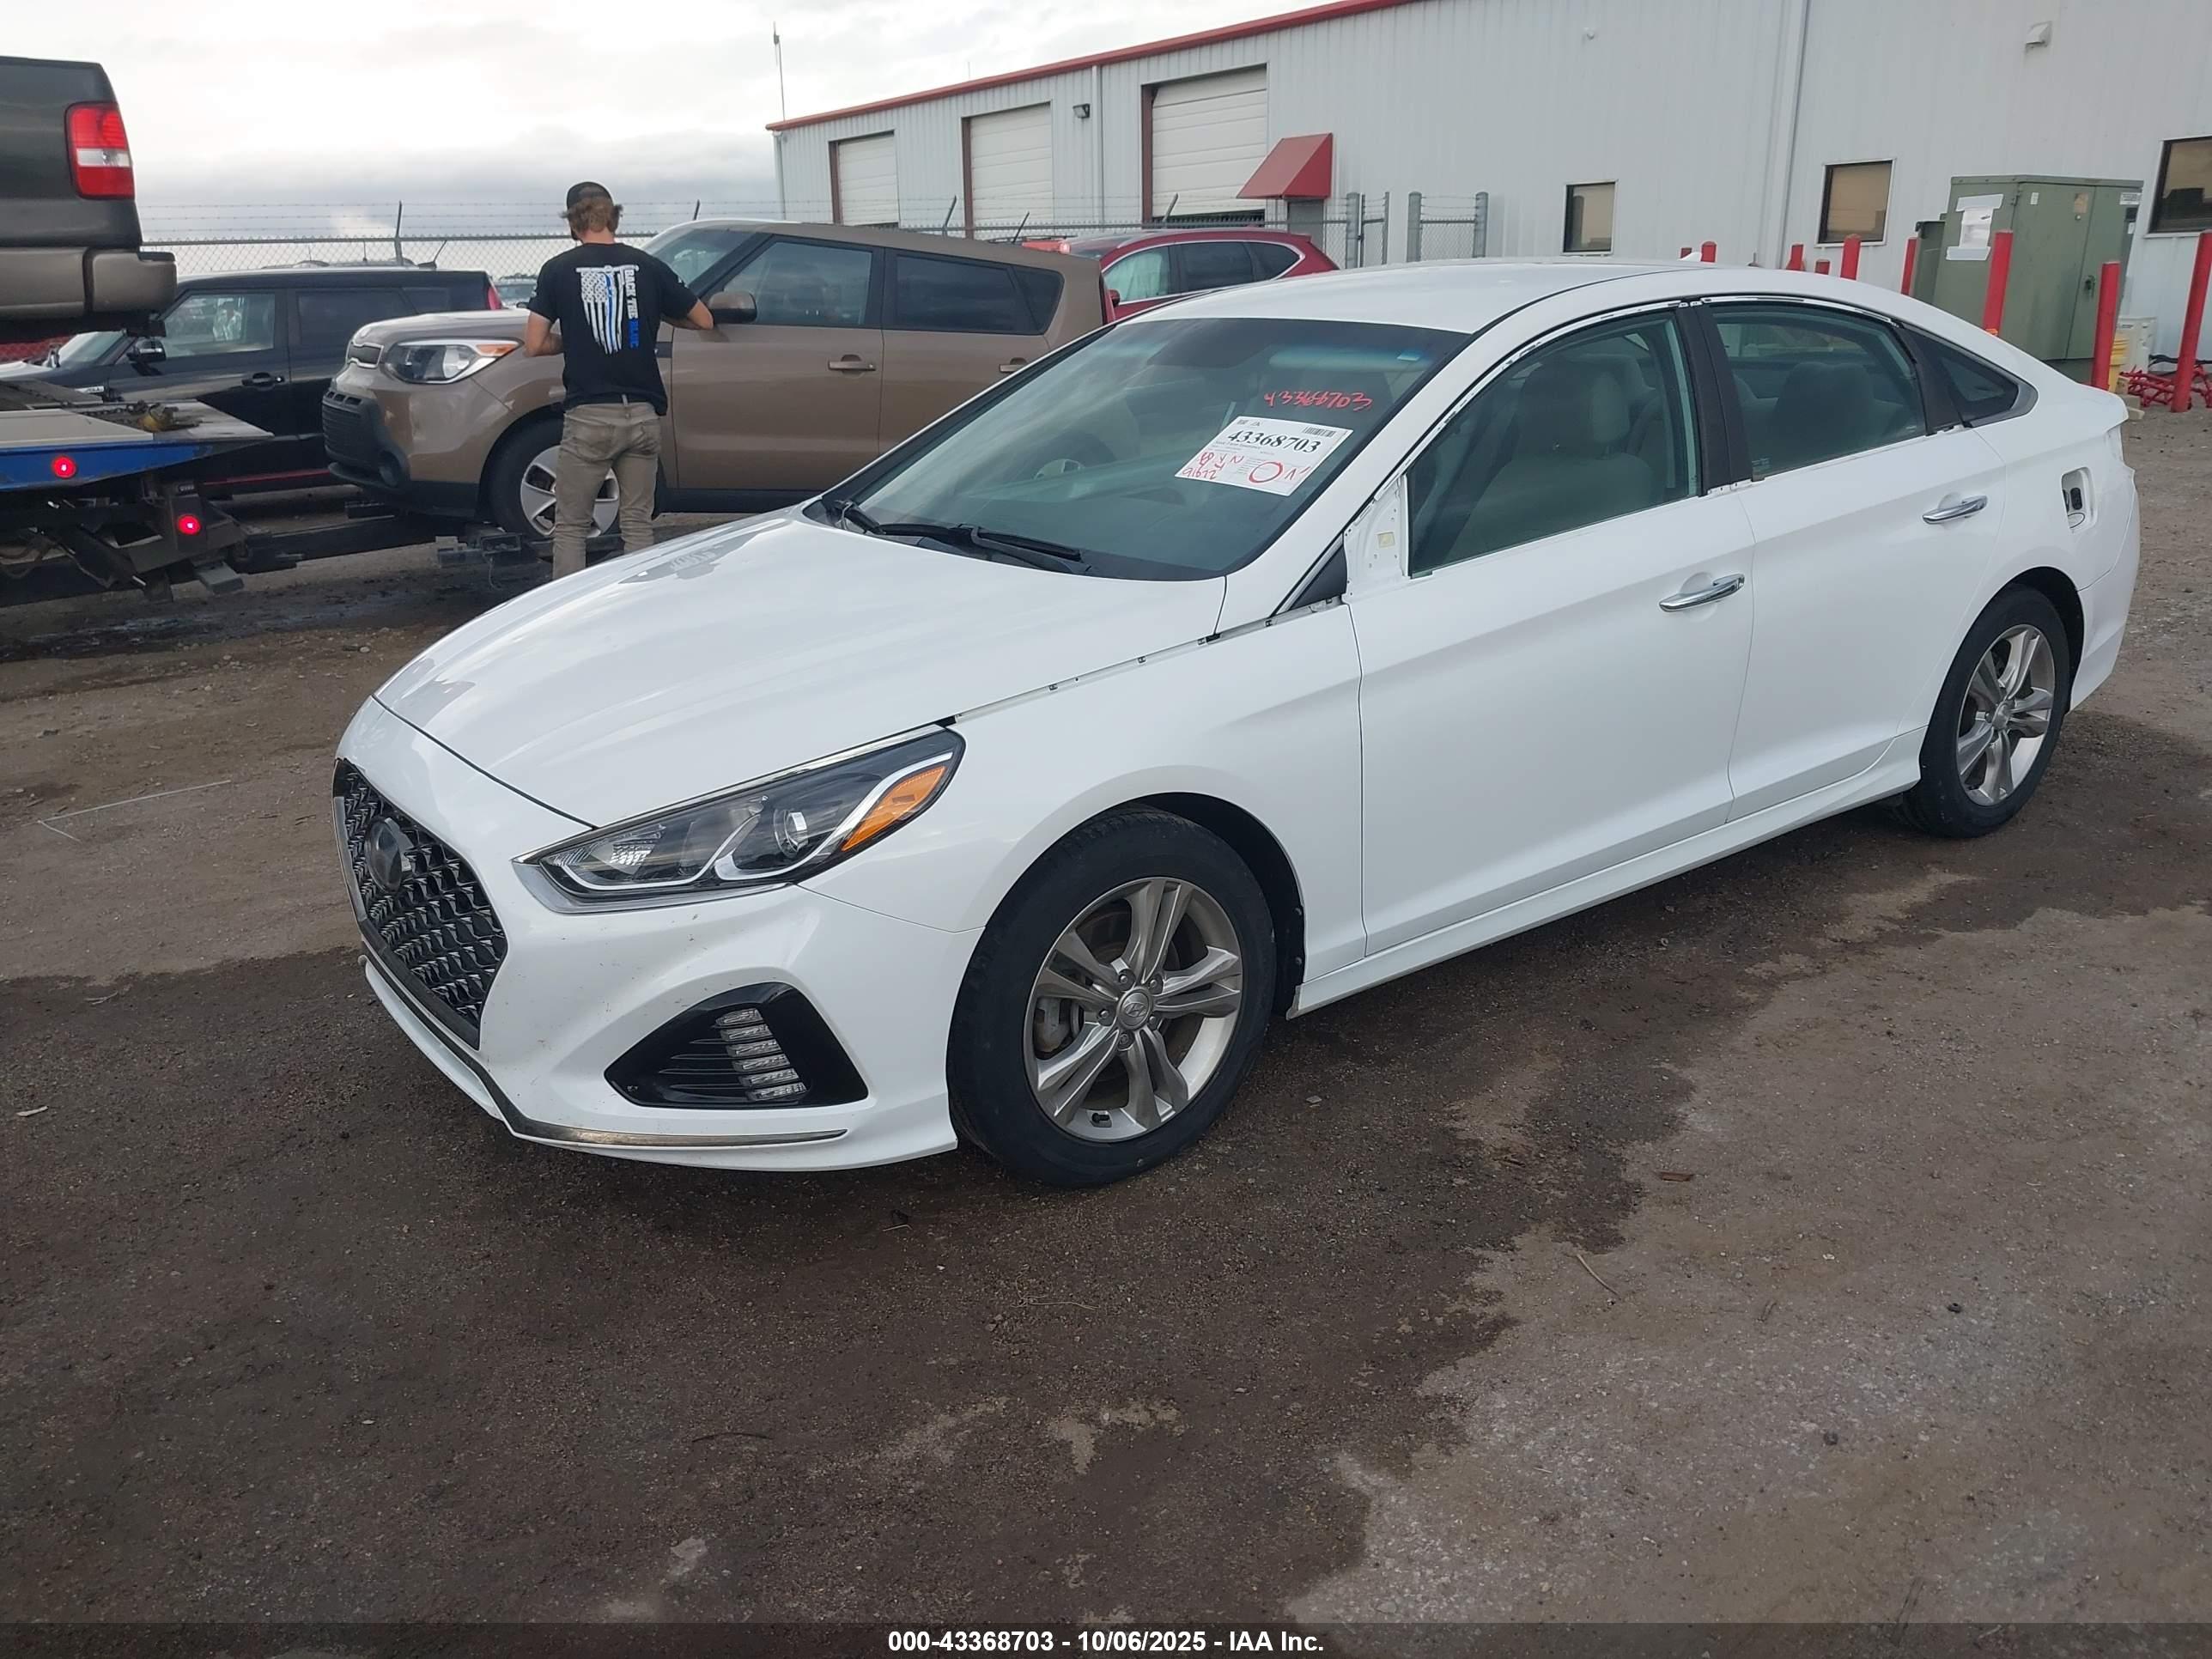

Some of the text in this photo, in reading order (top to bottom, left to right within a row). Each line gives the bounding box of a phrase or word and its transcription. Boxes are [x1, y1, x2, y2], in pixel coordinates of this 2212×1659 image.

[624, 270, 635, 296] BACK
[627, 297, 638, 319] THE
[1228, 429, 1322, 453] 43368703
